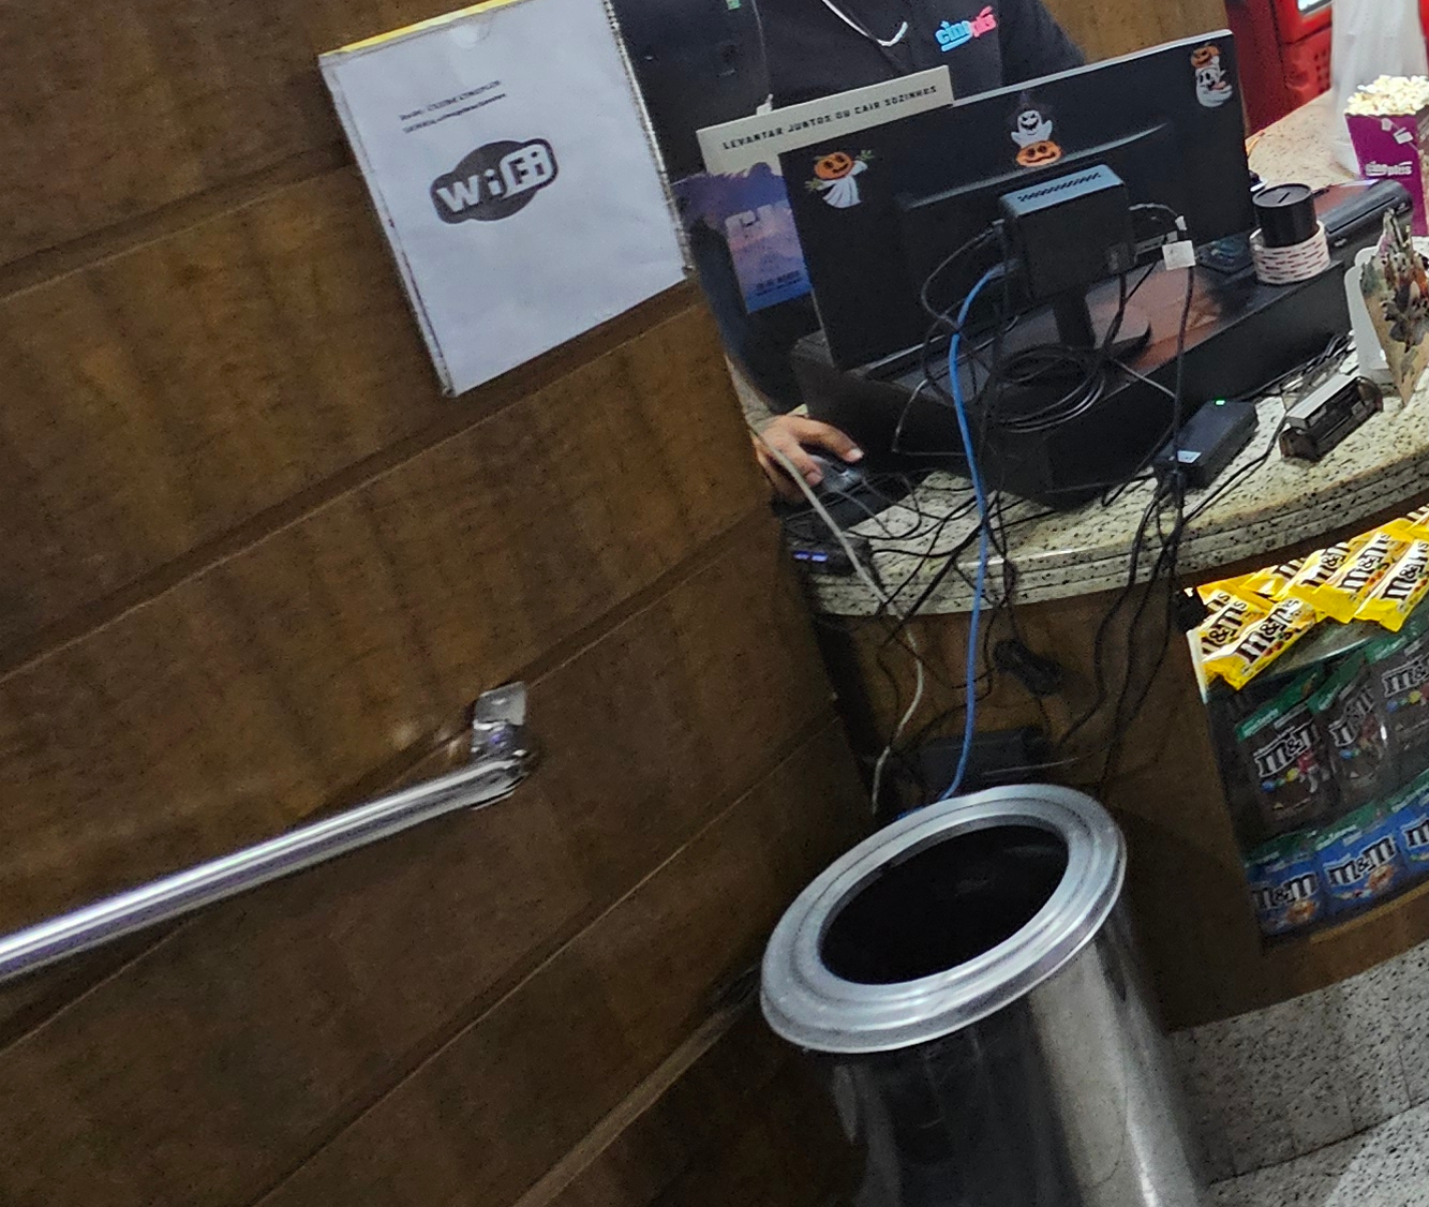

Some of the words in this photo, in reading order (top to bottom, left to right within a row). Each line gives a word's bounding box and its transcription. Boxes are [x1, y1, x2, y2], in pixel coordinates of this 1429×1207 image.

[722, 126, 784, 150] LEVANTAR
[788, 114, 833, 134] JUNTOS
[854, 101, 881, 116] CAIR
